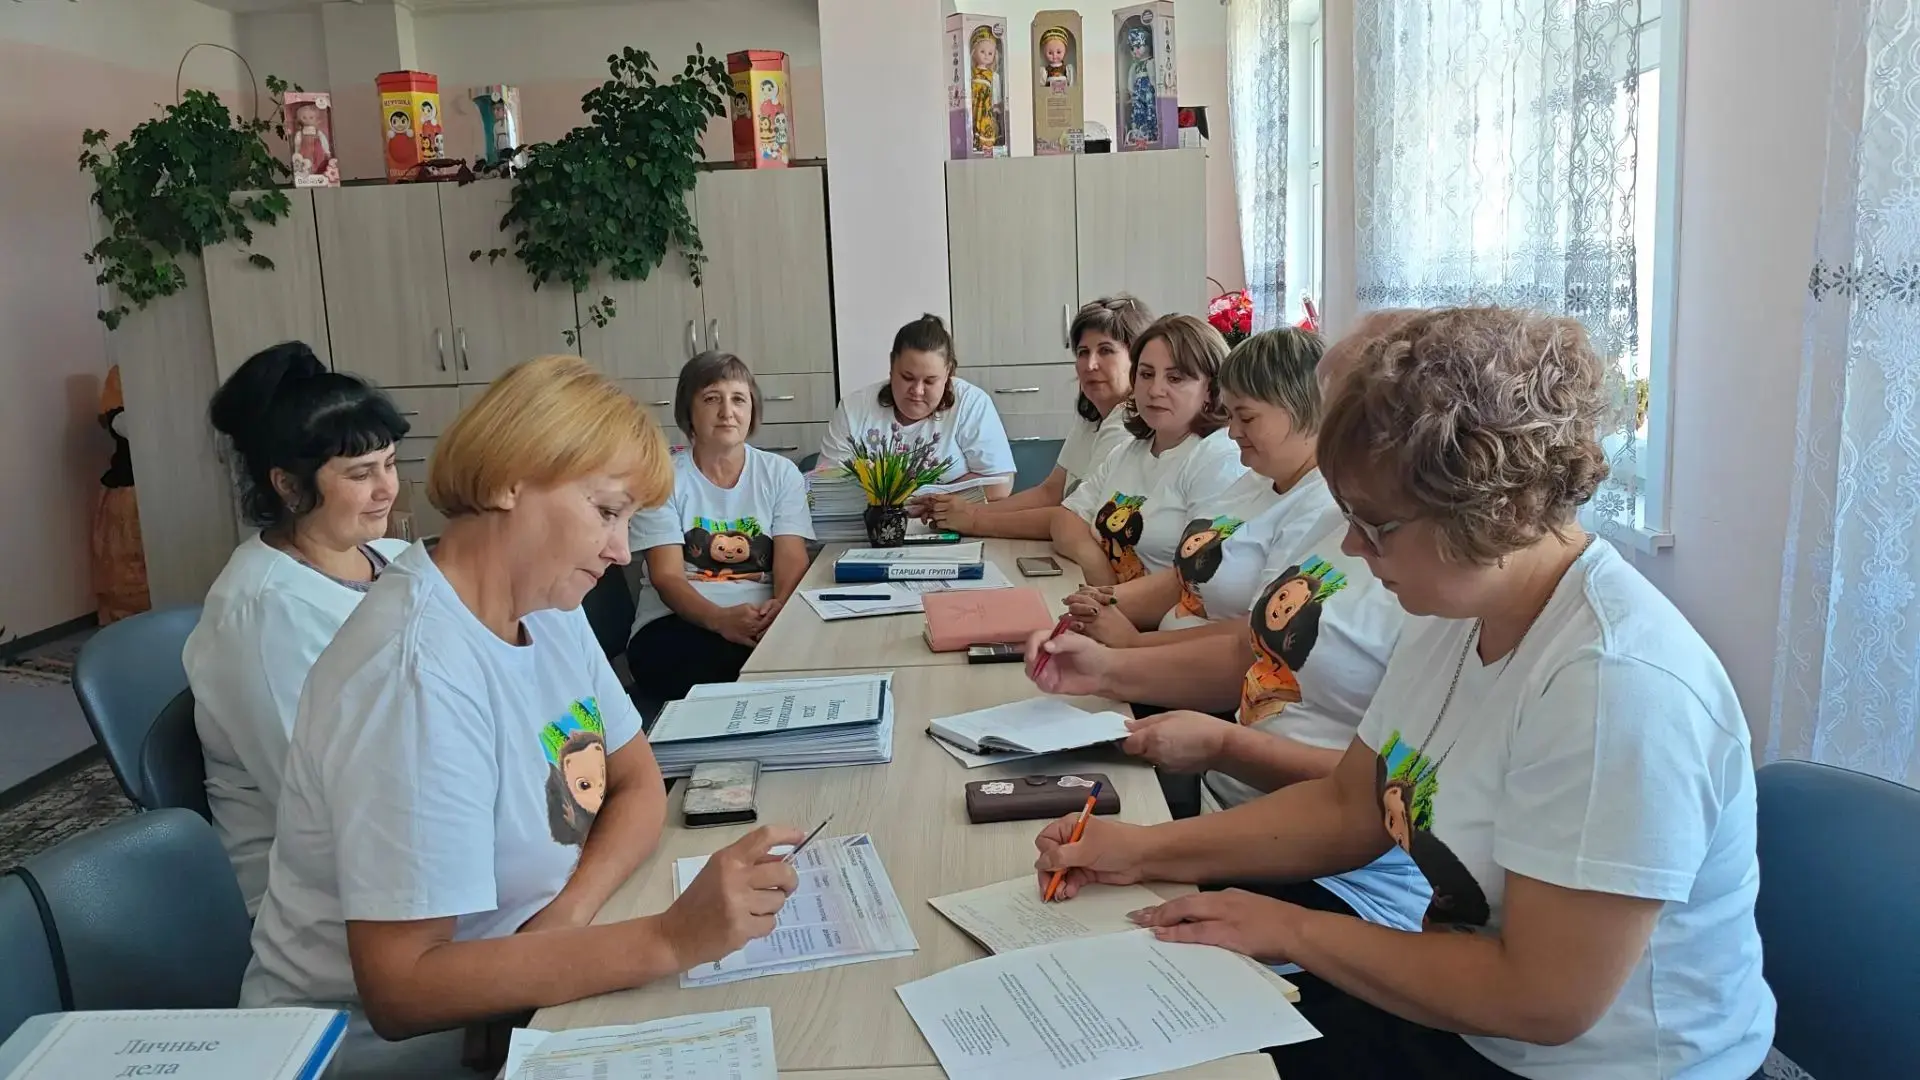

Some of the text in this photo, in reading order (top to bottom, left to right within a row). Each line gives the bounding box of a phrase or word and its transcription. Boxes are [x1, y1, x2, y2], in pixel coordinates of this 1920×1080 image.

[891, 566, 957, 576] СТАРШАЯ ГРУППА
[115, 1038, 220, 1056] Личные
[115, 1062, 181, 1079] дела
